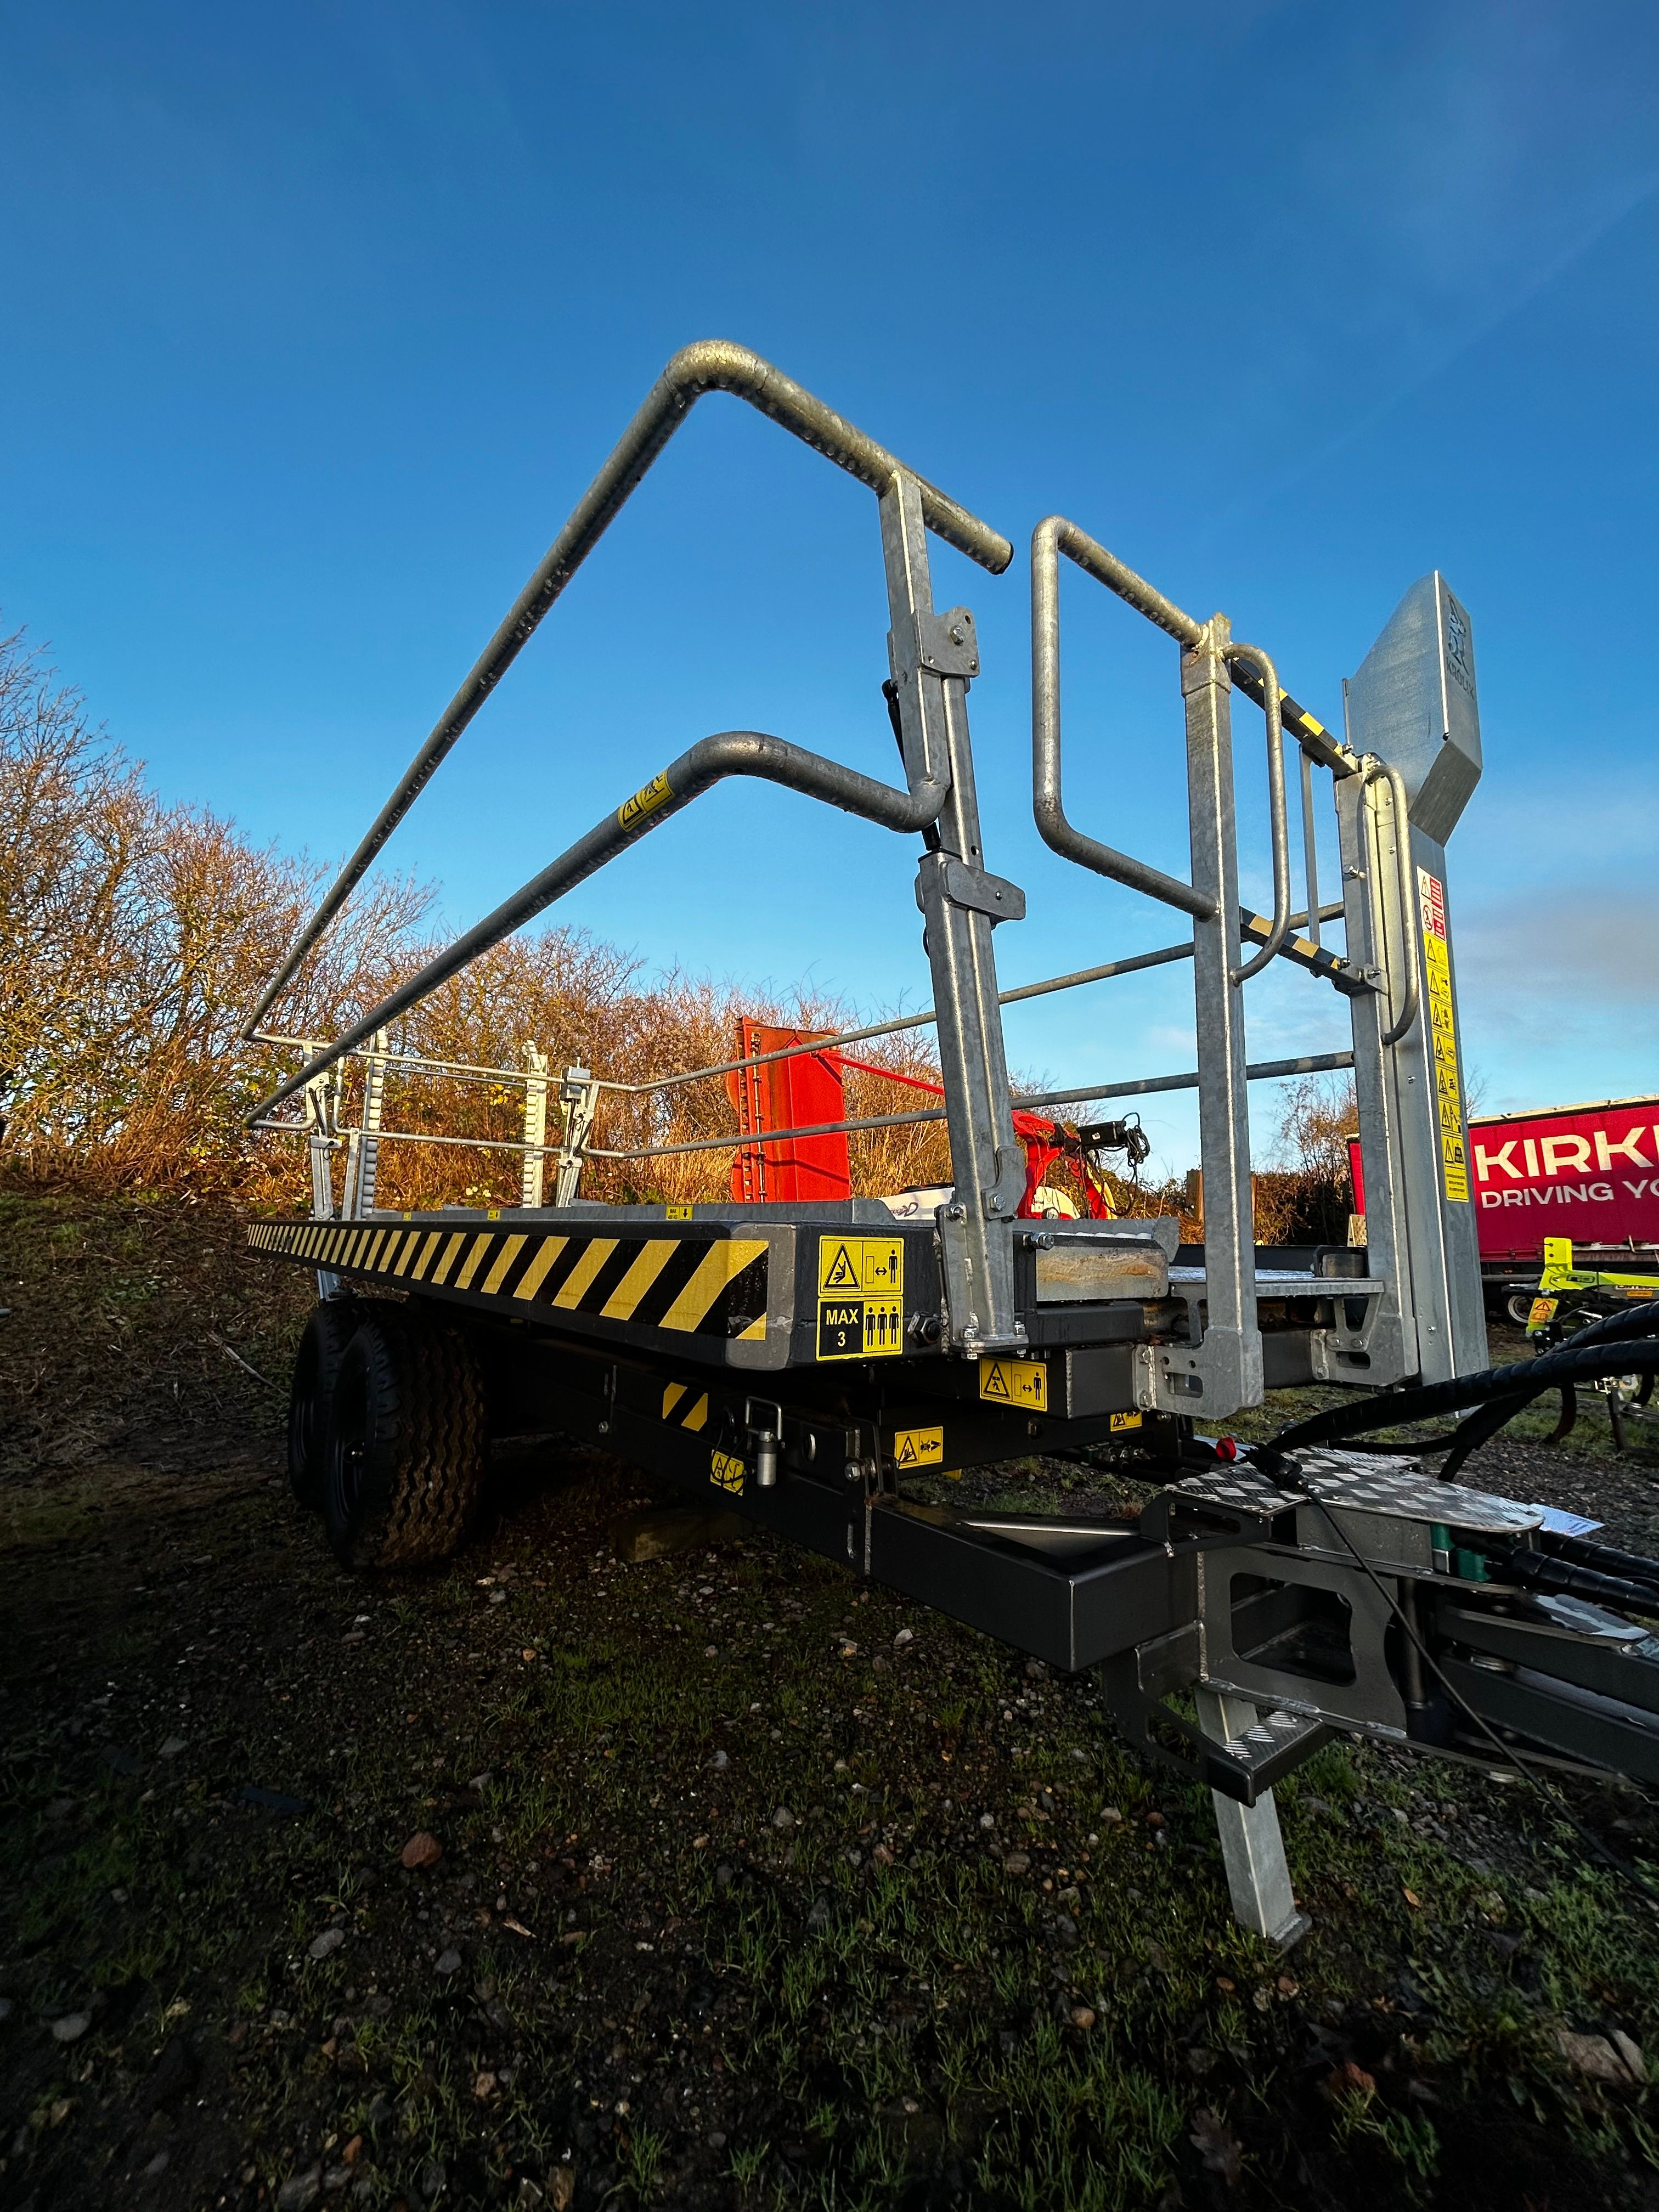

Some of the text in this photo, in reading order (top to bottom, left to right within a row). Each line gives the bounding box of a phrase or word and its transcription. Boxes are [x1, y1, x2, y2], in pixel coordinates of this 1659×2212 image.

[1474, 1125, 1659, 1182] KIRK
[1481, 1182, 1614, 1208] DRIVING
[826, 1308, 859, 1325] MAX
[837, 1331, 846, 1347] 3
